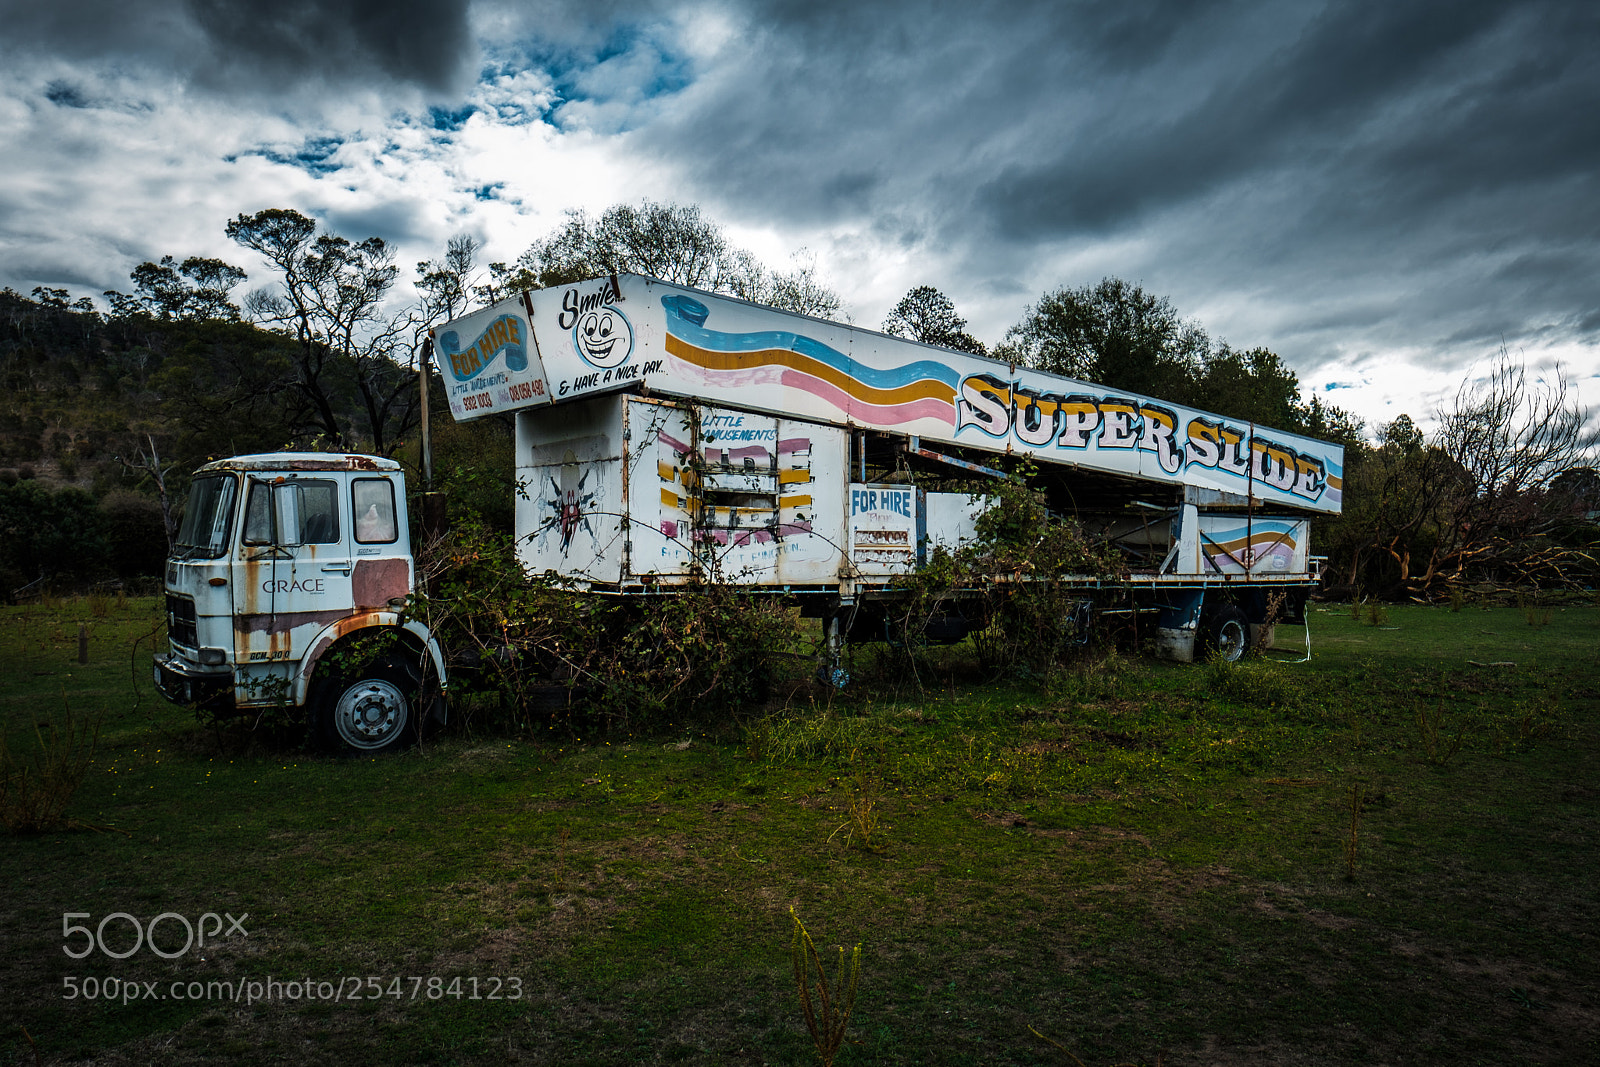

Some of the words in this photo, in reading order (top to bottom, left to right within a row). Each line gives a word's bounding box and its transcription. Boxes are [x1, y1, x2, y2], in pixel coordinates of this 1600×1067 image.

[449, 347, 482, 376] FOR
[478, 317, 520, 361] HIRE
[452, 383, 468, 396] LITTLE
[559, 380, 570, 396] &
[573, 372, 599, 391] HAVE
[603, 370, 612, 383] A
[615, 364, 639, 380] NICE
[702, 415, 744, 427] LITTLE
[703, 429, 778, 441] AMUSEMENTS
[959, 374, 1182, 474] SUPER
[1185, 416, 1326, 502] SLIDE
[852, 490, 877, 516] FOR
[881, 491, 911, 518] HIRE
[262, 579, 325, 593] GRACE
